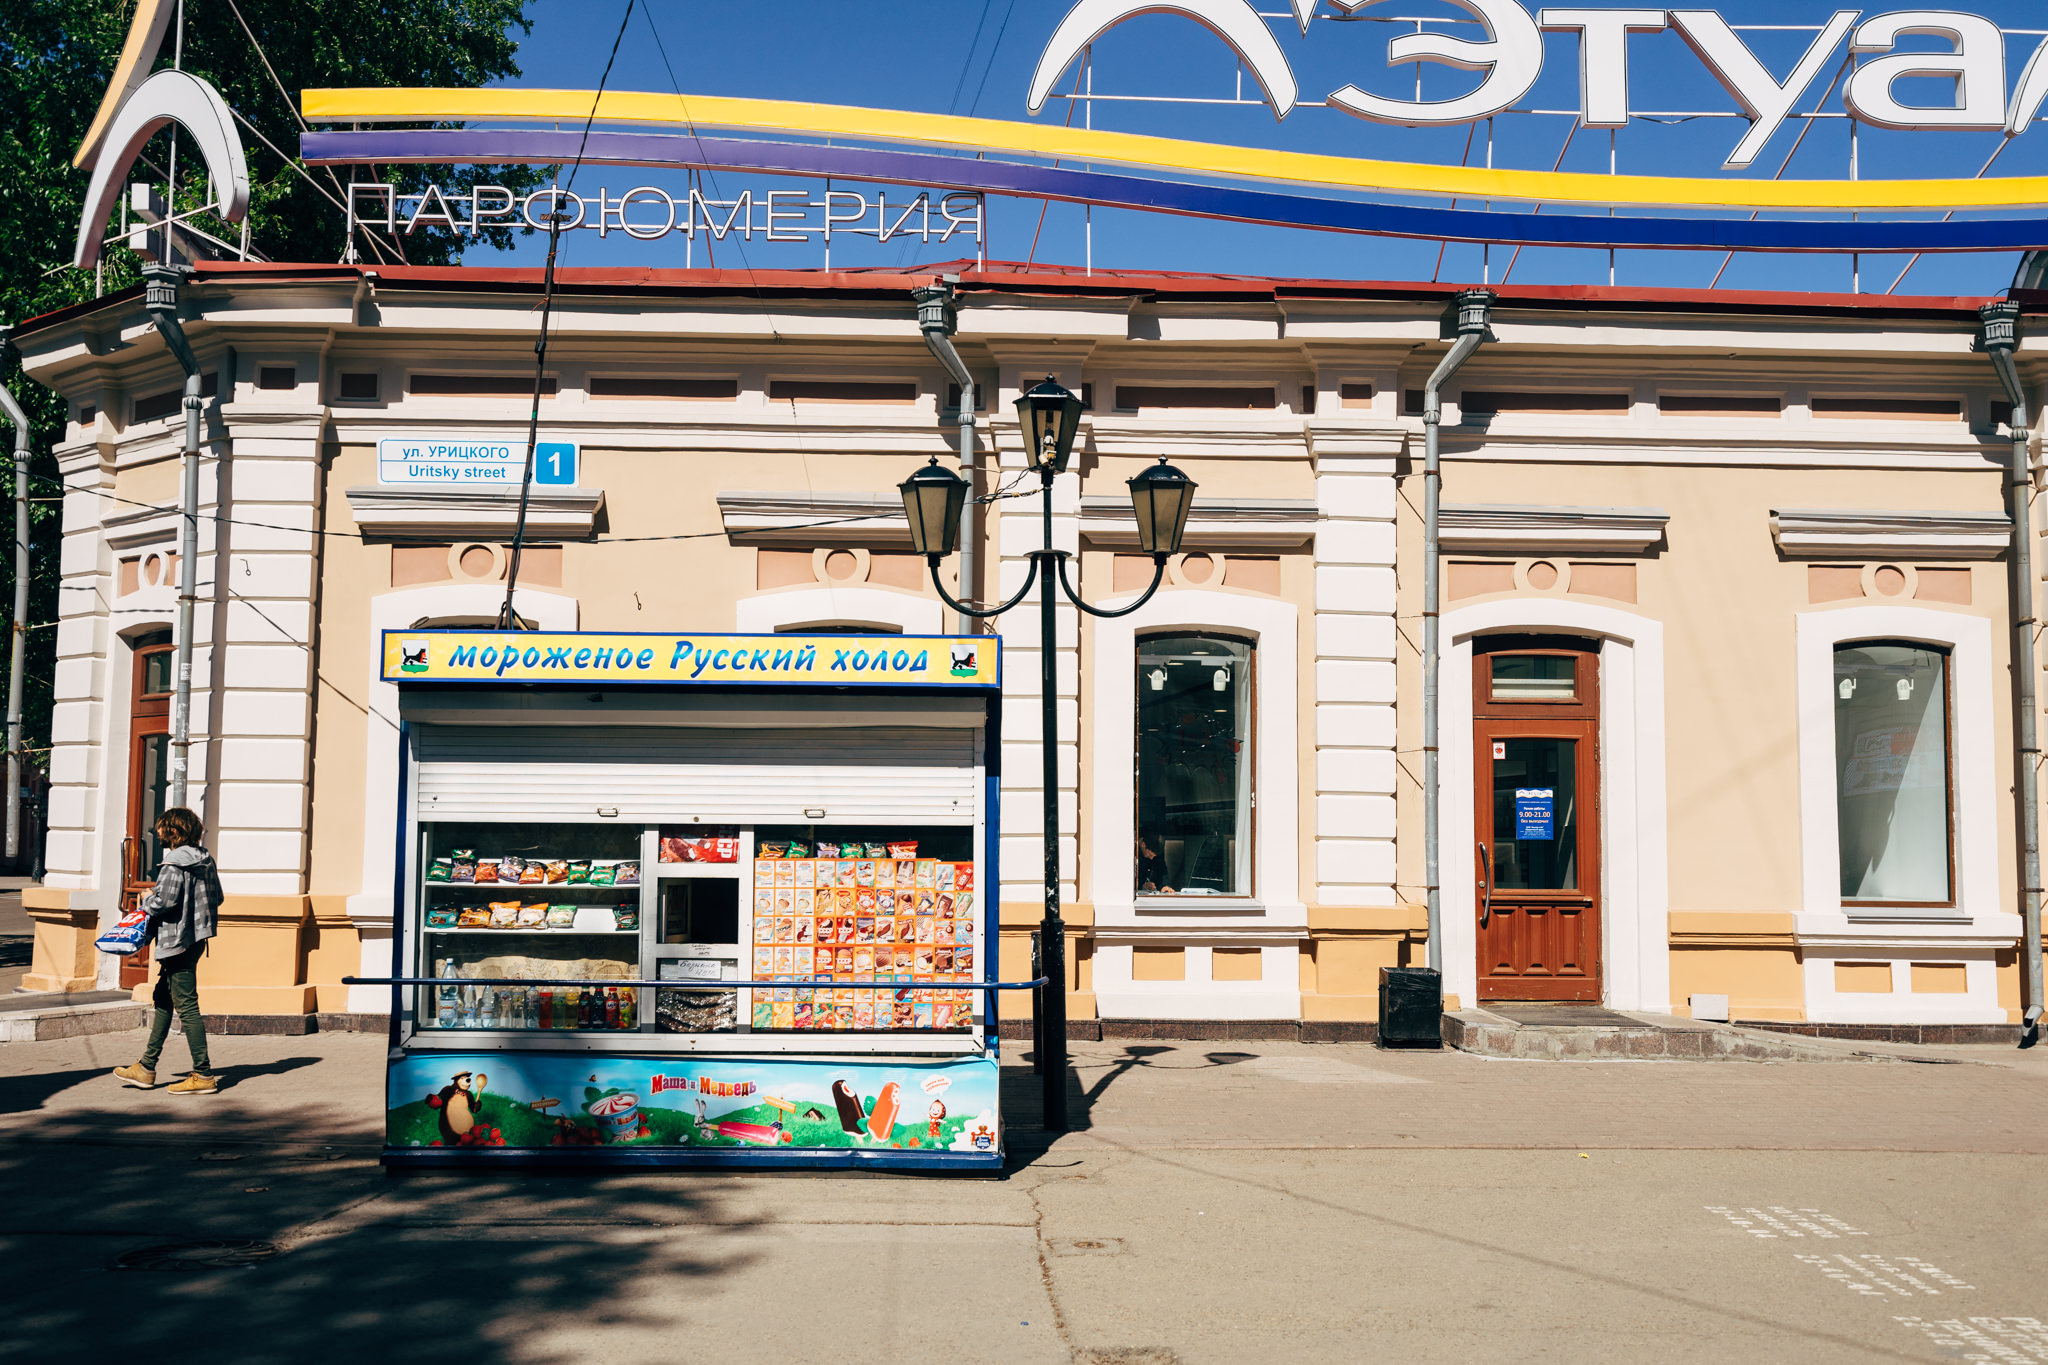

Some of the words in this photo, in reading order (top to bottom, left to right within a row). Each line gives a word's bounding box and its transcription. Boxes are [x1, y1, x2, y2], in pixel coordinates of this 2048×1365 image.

[347, 182, 984, 245] ПАРФЮМЕРИЯ
[403, 448, 424, 460] ул.
[428, 445, 510, 460] УРИЦКОГО
[548, 451, 560, 477] 1
[408, 464, 460, 480] Uritsky
[464, 466, 506, 478] street
[448, 643, 654, 676] мороженое
[671, 640, 815, 679] Русский
[830, 650, 929, 672] холод
[651, 1074, 687, 1094] Маша
[699, 1076, 757, 1097] Медведь
